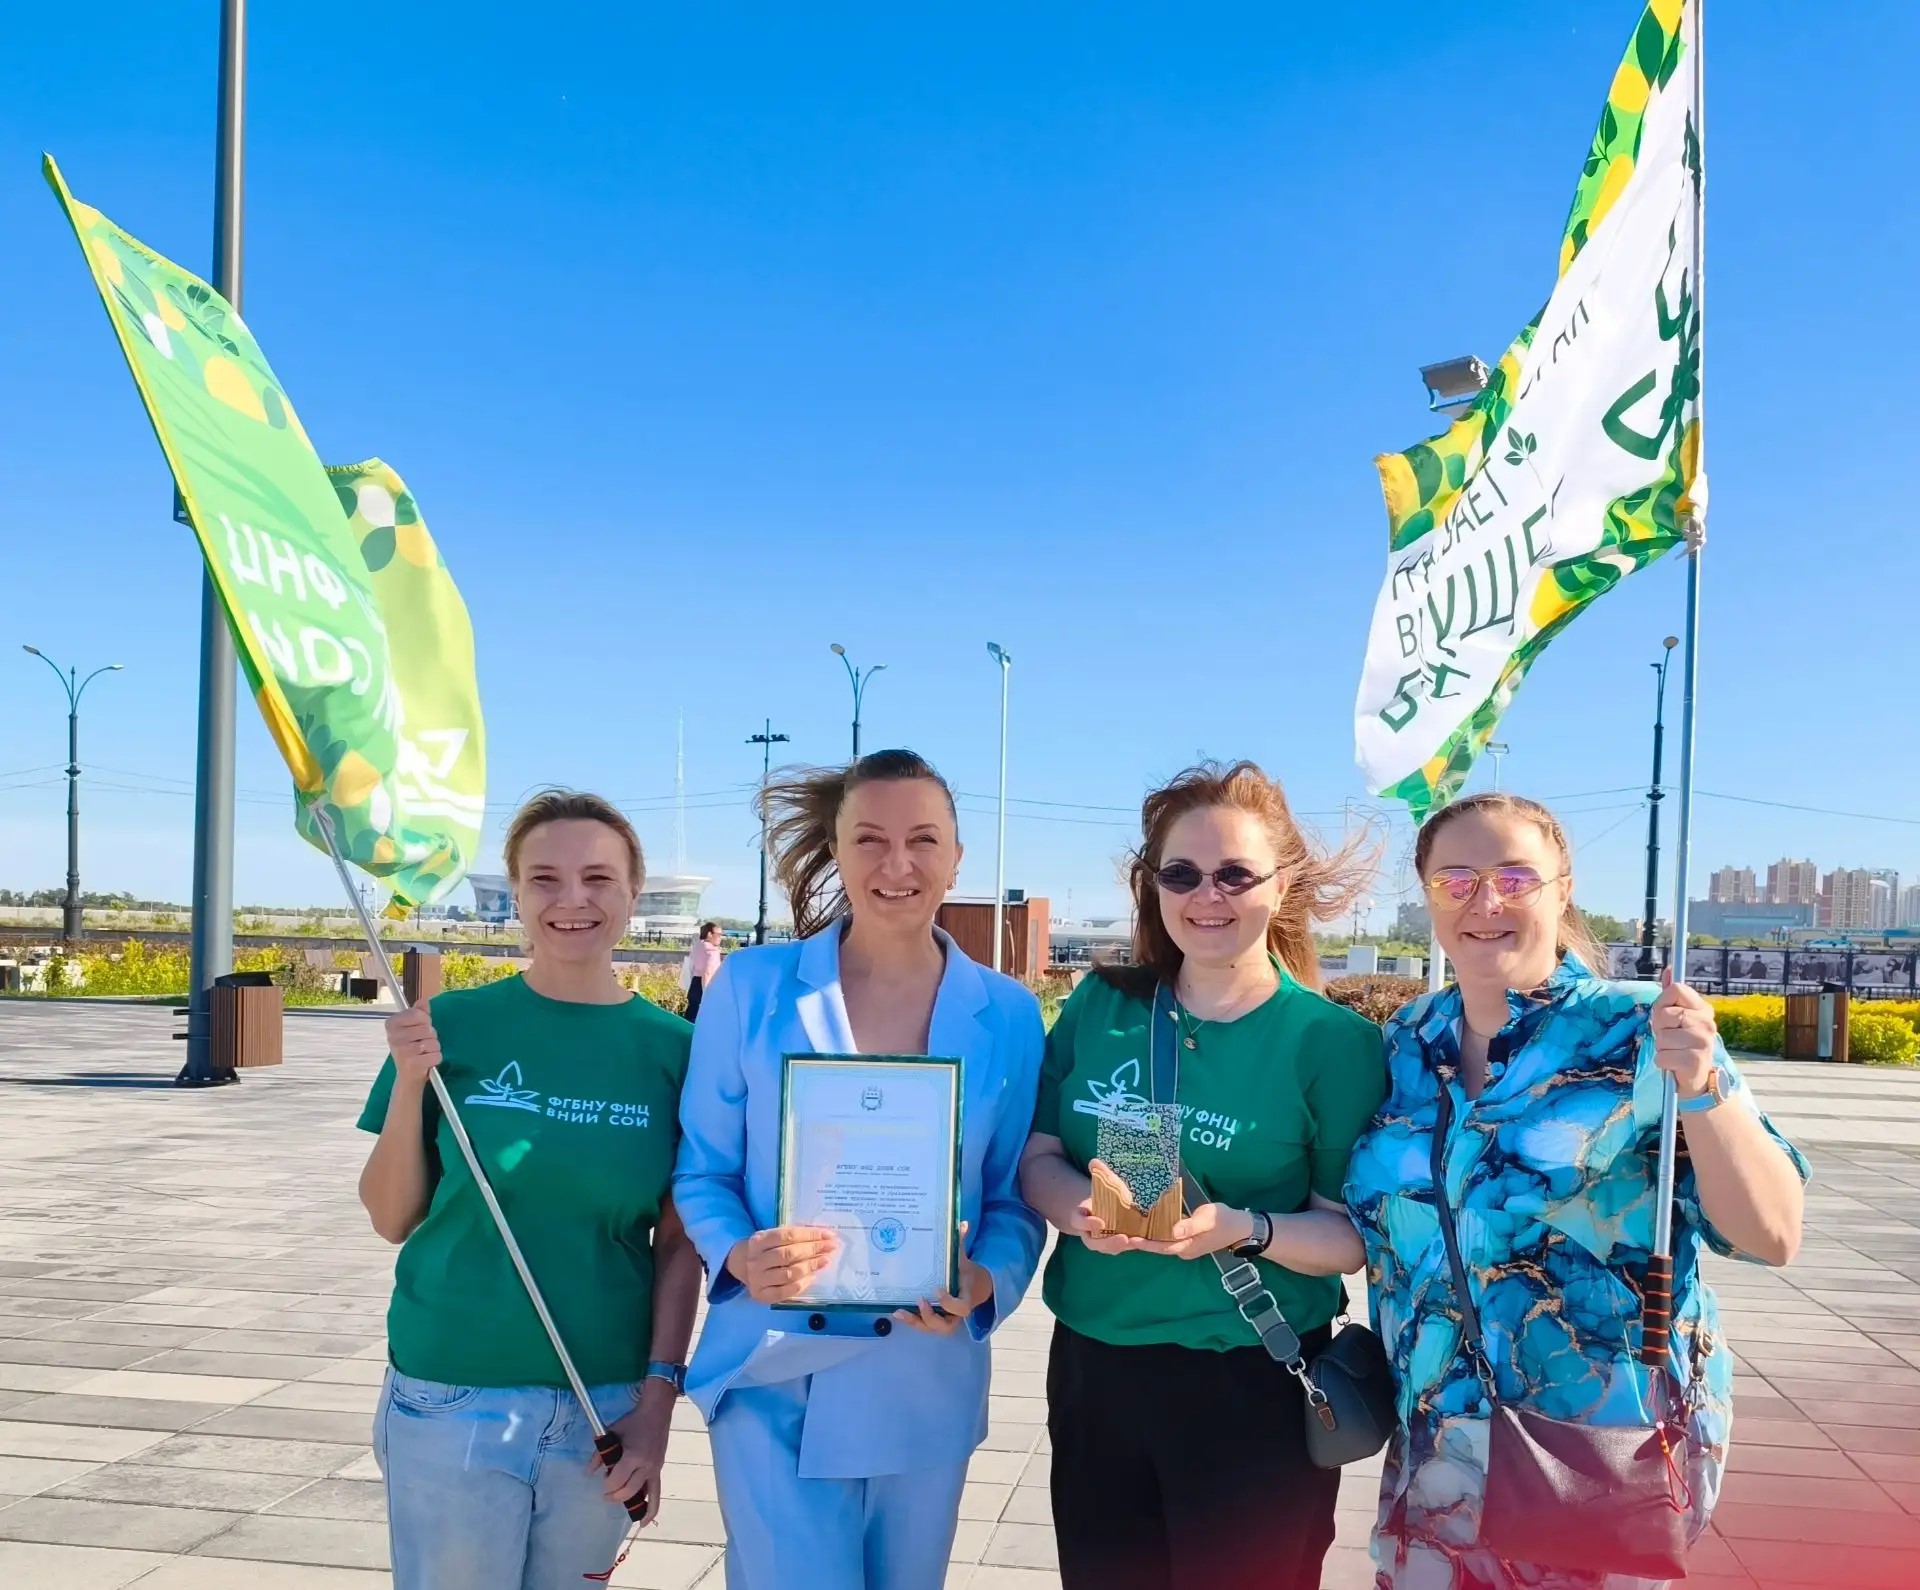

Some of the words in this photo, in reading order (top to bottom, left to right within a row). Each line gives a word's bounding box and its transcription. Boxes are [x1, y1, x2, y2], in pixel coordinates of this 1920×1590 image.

[546, 1107, 599, 1124] ВНИИ
[608, 1114, 648, 1128] СОИ
[548, 1096, 607, 1112] ФГБНУ
[610, 1103, 650, 1117] ФНЦ
[1195, 1109, 1238, 1135] ФНЦ
[1189, 1127, 1232, 1151] СОИ
